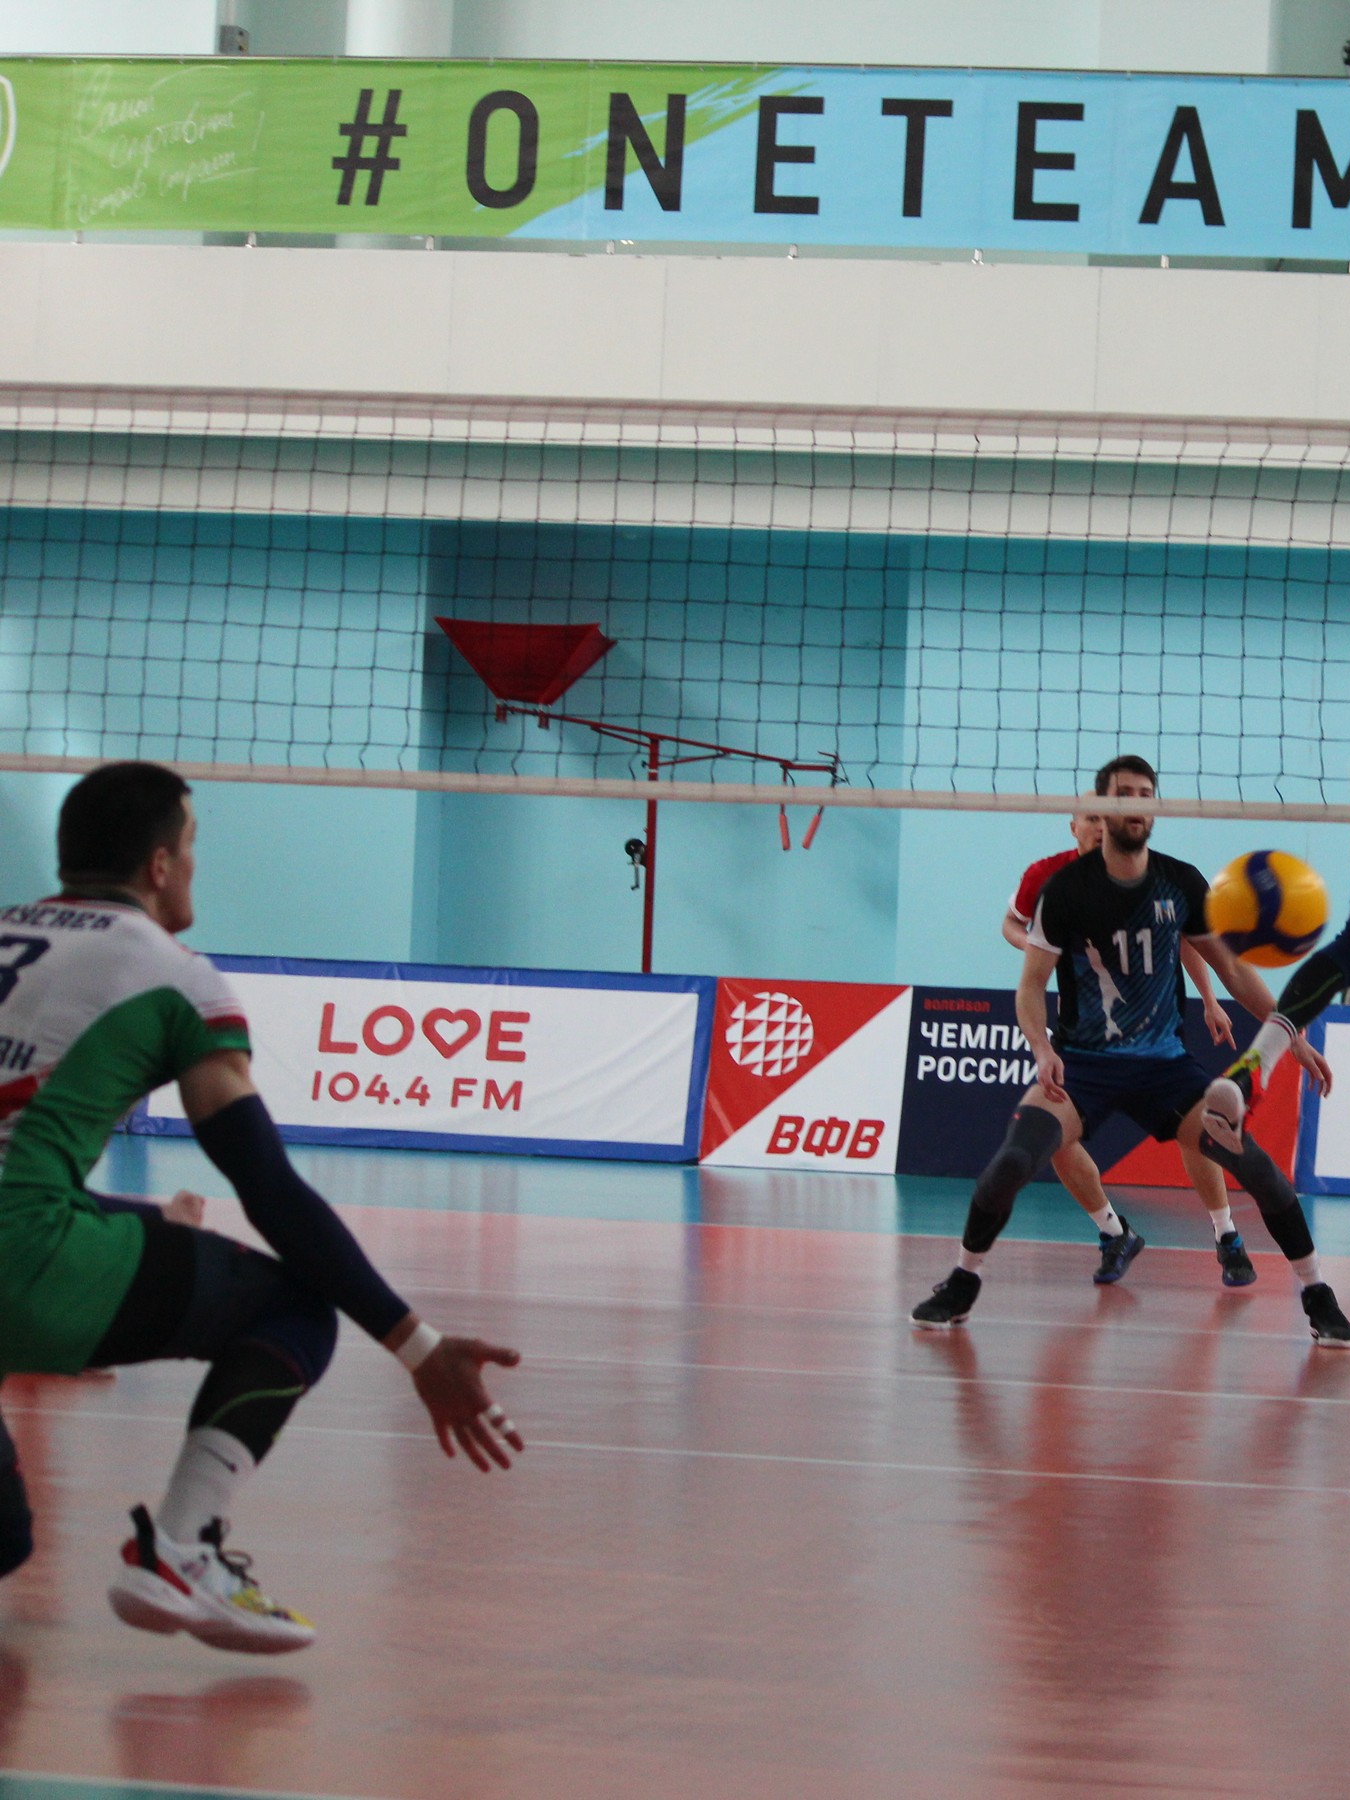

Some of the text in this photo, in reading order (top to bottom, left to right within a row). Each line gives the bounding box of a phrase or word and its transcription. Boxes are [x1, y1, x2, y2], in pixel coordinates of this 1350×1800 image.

[1112, 928, 1154, 976] 11
[311, 1070, 523, 1111] 104.4 FM
[766, 1115, 885, 1158] ВФВ
